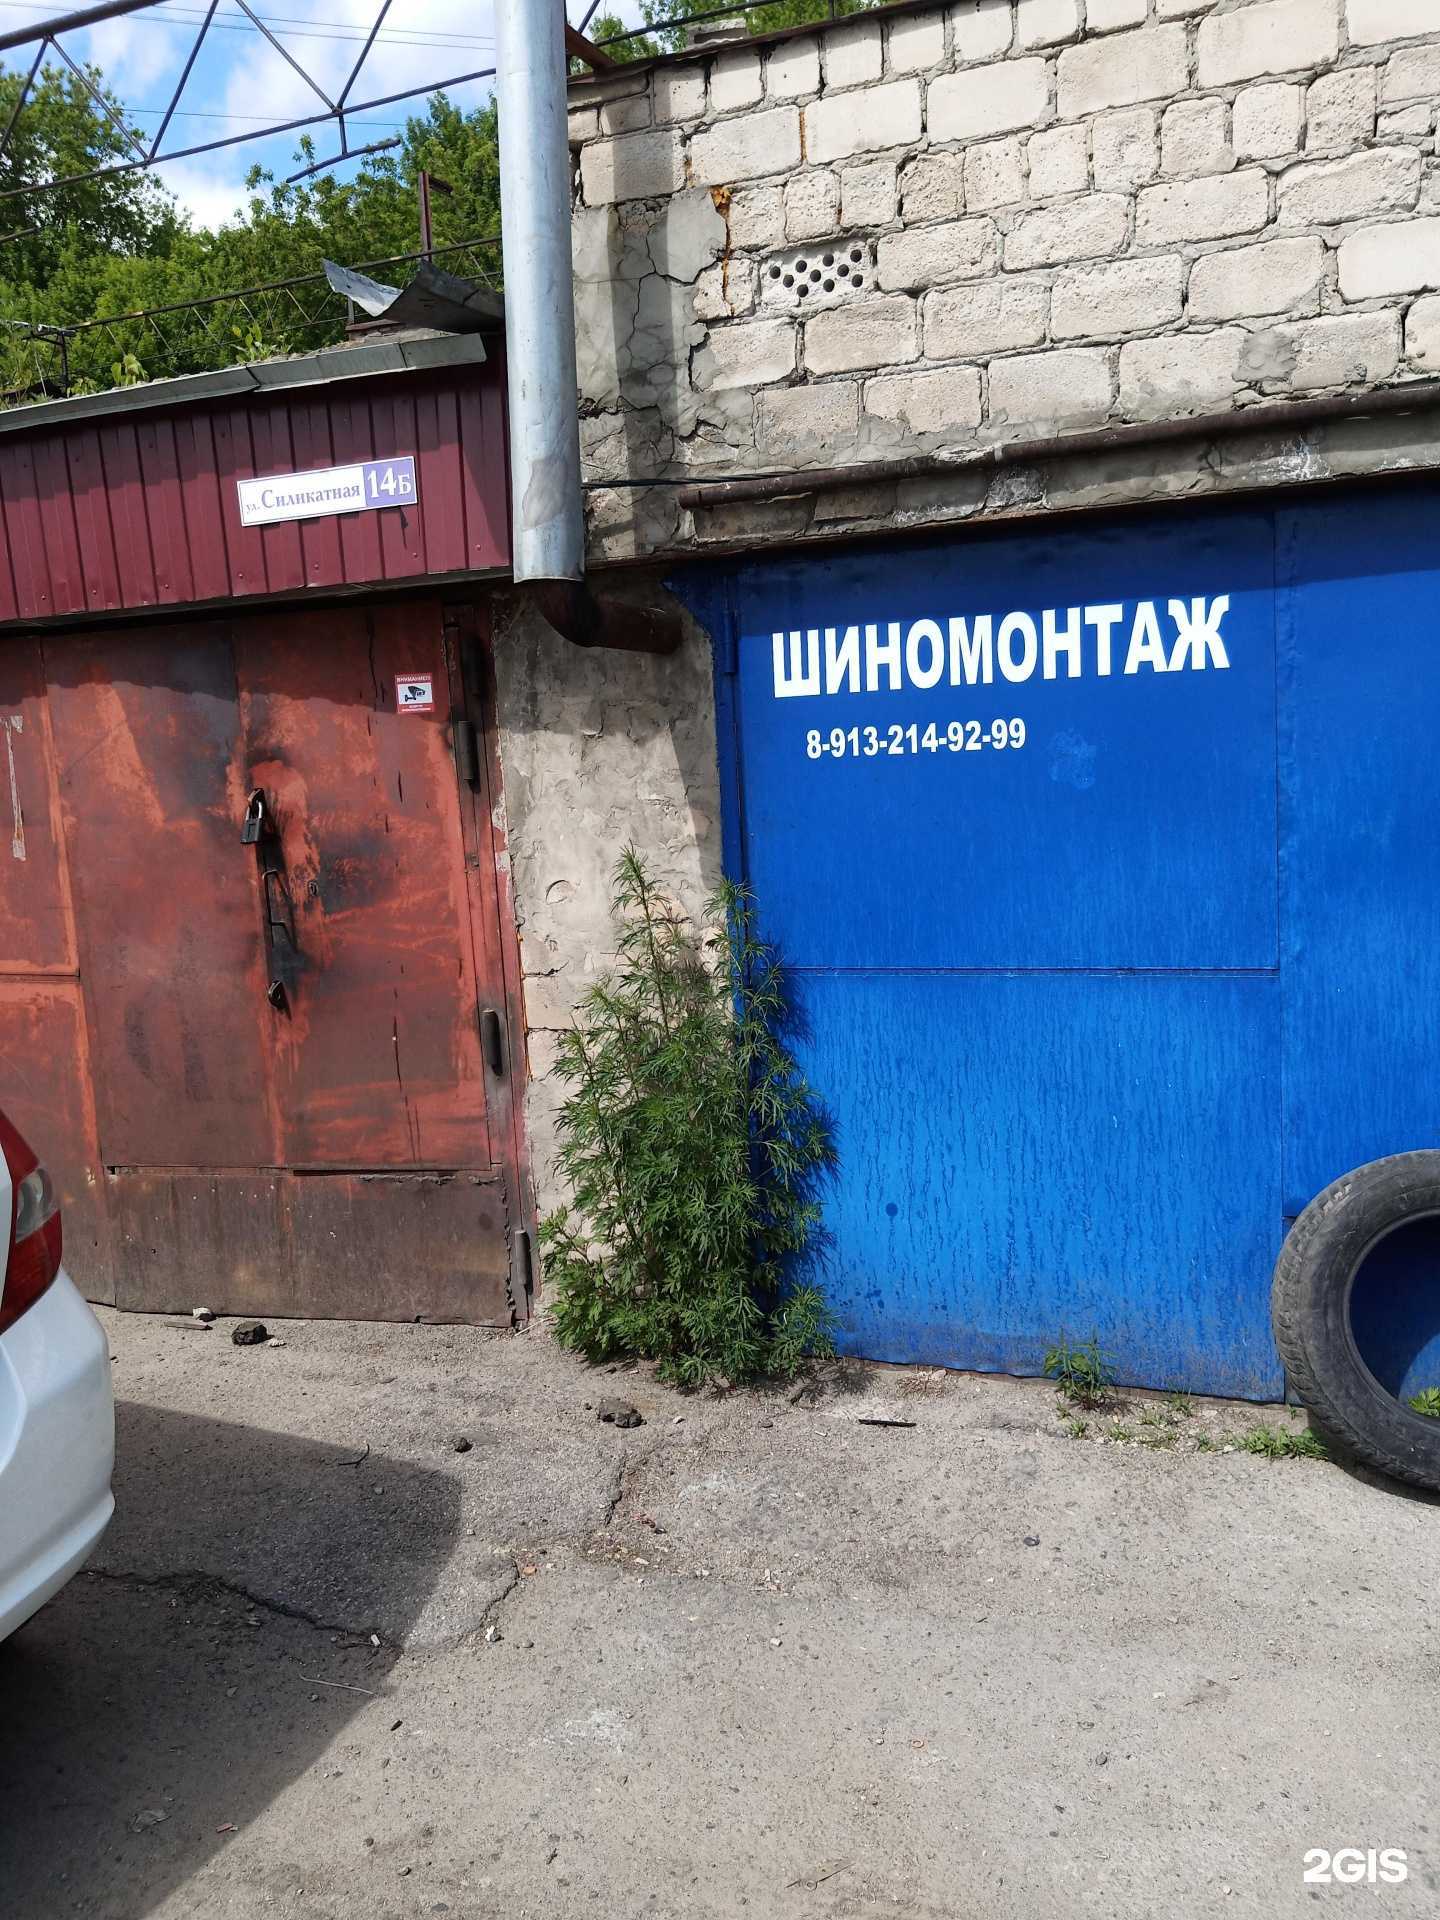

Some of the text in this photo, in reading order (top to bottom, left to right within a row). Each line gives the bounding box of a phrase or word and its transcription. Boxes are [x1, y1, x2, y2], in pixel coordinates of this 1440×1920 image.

[246, 467, 412, 514] ул. Силикатная 14Б
[772, 595, 1230, 698] ШИНОМОНТАЖ
[806, 718, 1026, 759] 8-913-214-92-99
